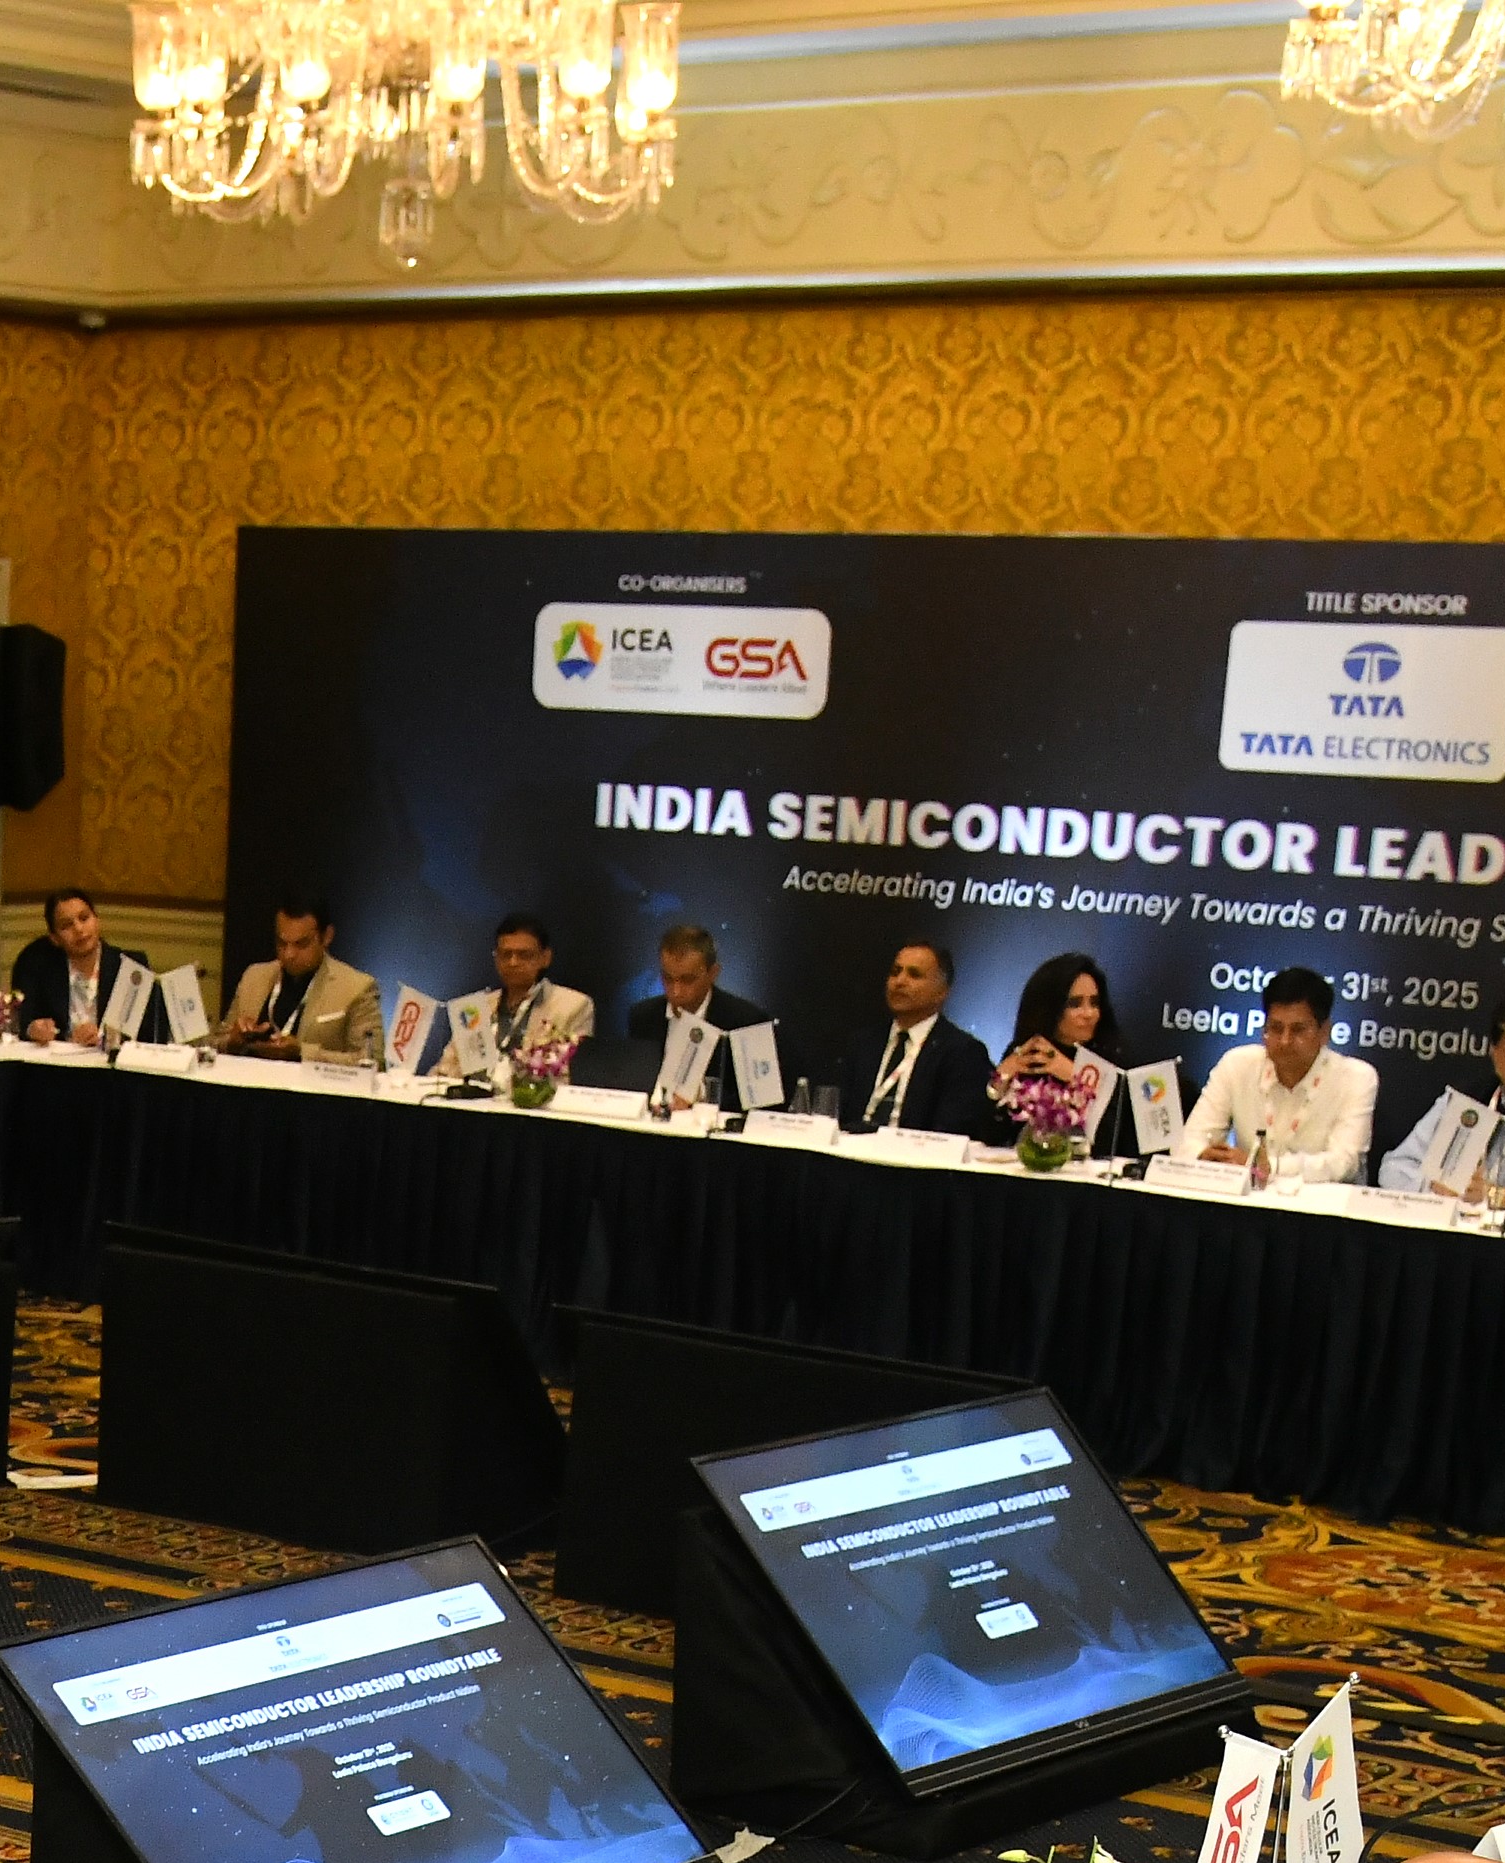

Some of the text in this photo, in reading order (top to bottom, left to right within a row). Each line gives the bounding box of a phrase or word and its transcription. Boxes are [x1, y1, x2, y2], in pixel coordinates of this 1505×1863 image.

[618, 574, 747, 594] CO-ORGANISERS
[1306, 591, 1468, 616] TITLE SPONSOR
[611, 628, 673, 651] ICEA
[705, 636, 807, 681] GSA
[1330, 695, 1405, 718] TATA
[1240, 733, 1490, 765] TATA ELECTRONICS
[594, 782, 753, 839] INDIA
[766, 791, 1316, 876] SEMICONDUCTOR
[782, 864, 955, 909] Accelerating
[1060, 885, 1180, 924] Journey
[1189, 892, 1316, 931] Towards
[1324, 910, 1346, 932] a
[1355, 904, 1483, 948] Thriving
[1403, 977, 1479, 1009] 2025
[1162, 1003, 1238, 1035] Leela
[1359, 1021, 1491, 1061] Bengalu
[132, 1647, 503, 1755] INDIA SEMICONDUCTOR LEADERSHIP ROUNDTABLE
